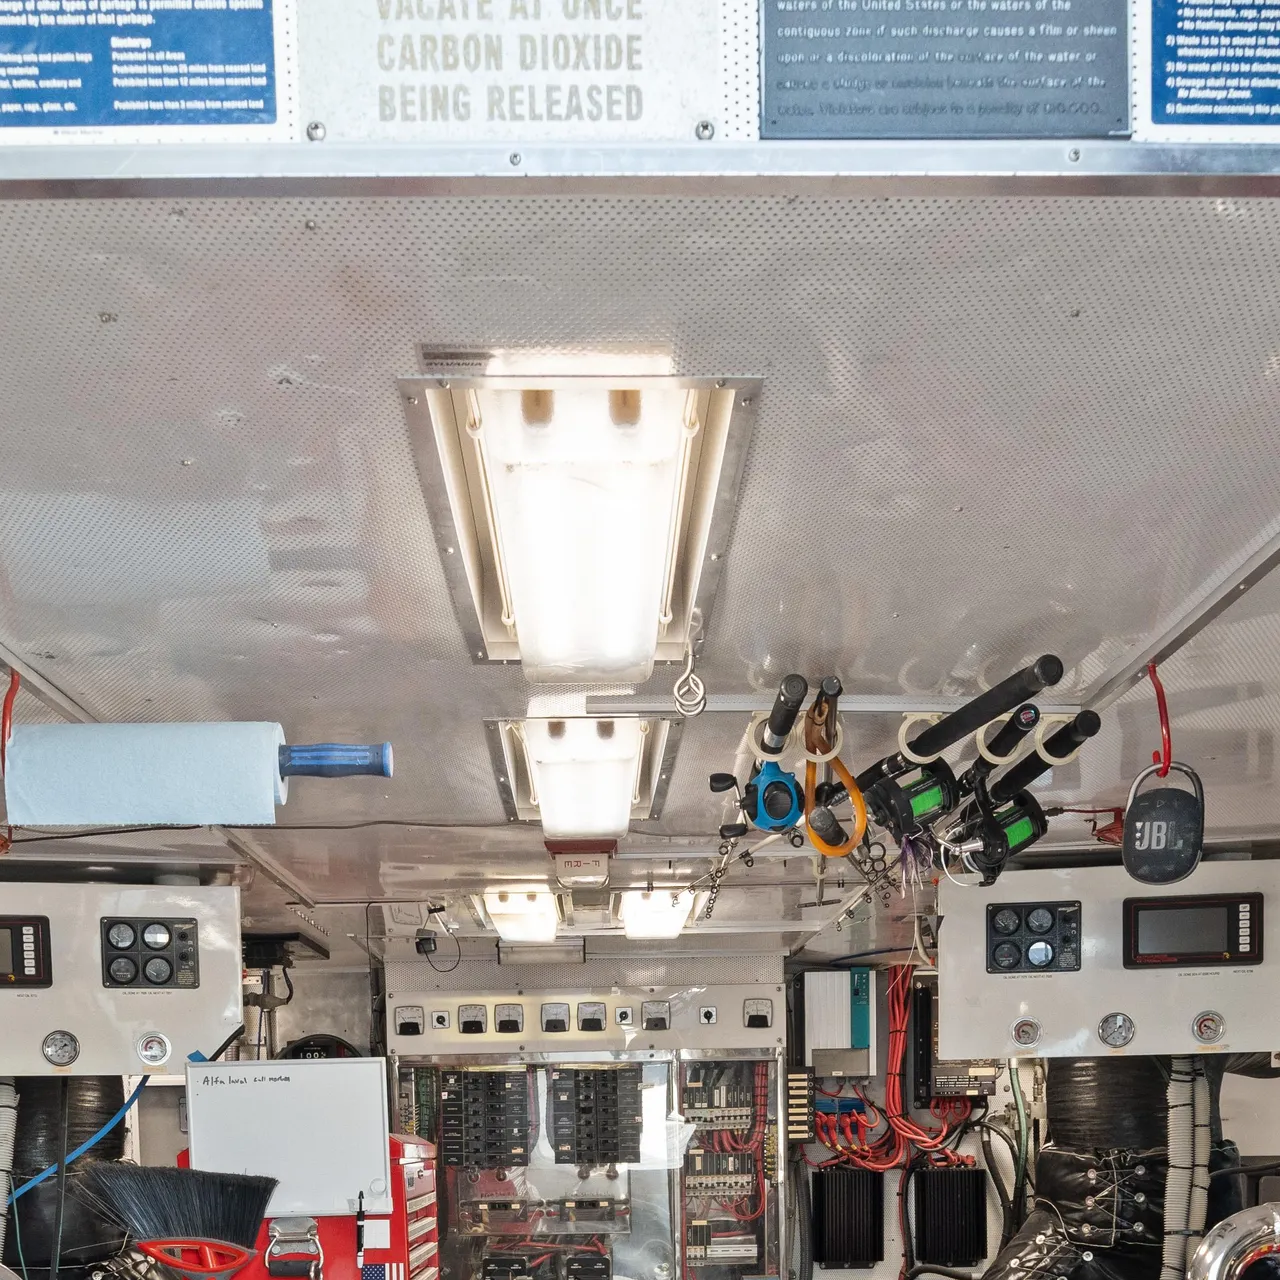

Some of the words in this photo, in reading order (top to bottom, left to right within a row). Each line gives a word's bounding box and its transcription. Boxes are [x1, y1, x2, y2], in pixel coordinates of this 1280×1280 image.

[777, 0, 817, 11] waters
[822, 0, 833, 11] of
[838, 0, 856, 11] the
[861, 0, 901, 11] United
[905, 0, 946, 11] States
[951, 0, 961, 11] or
[968, 0, 986, 11] the
[991, 0, 1031, 11] waters
[1035, 0, 1047, 11] of
[1052, 0, 1070, 11] the
[777, 27, 841, 38] contiguous
[846, 27, 871, 36] zone
[877, 25, 886, 36] if
[891, 25, 917, 36] such
[923, 25, 979, 38] discharge
[984, 27, 1024, 36] causes
[1029, 27, 1035, 36] a
[1040, 25, 1063, 36] film
[1067, 27, 1078, 36] or
[1084, 25, 1117, 36] sheen
[377, 34, 503, 72] CARBON
[519, 34, 643, 71] DIOXIDE
[934, 52, 954, 63] the
[1008, 52, 1020, 63] of
[1024, 52, 1043, 63] the
[1048, 52, 1081, 63] water
[1085, 52, 1097, 63] or
[378, 84, 471, 122] BEING
[486, 84, 644, 122] RELEASED
[1134, 821, 1184, 851] JBL
